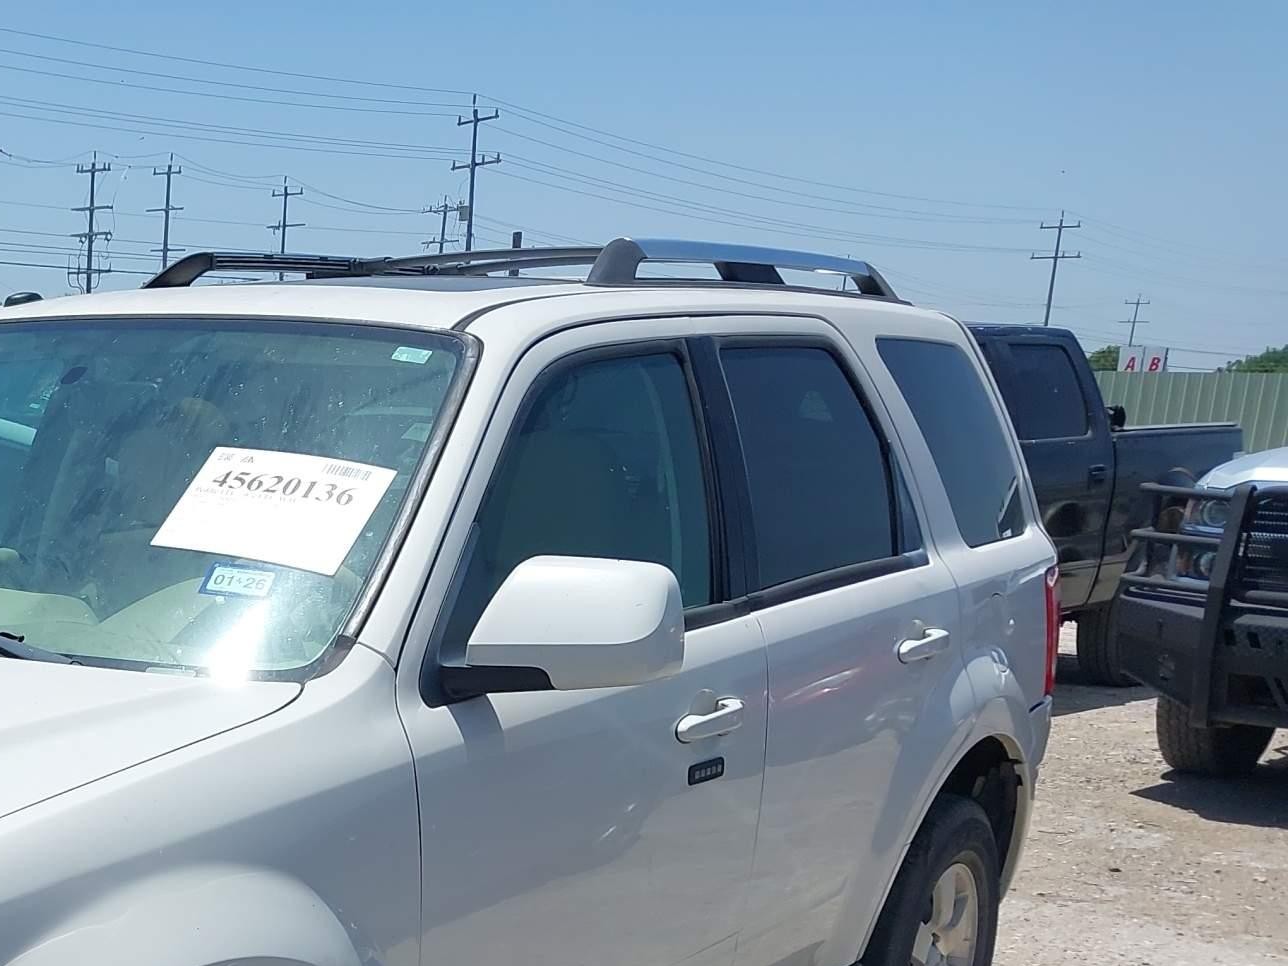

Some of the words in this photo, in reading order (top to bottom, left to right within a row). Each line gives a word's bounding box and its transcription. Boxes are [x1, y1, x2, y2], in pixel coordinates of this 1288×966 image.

[1124, 356, 1136, 371] A
[1148, 356, 1162, 371] B
[212, 470, 359, 506] 45620136
